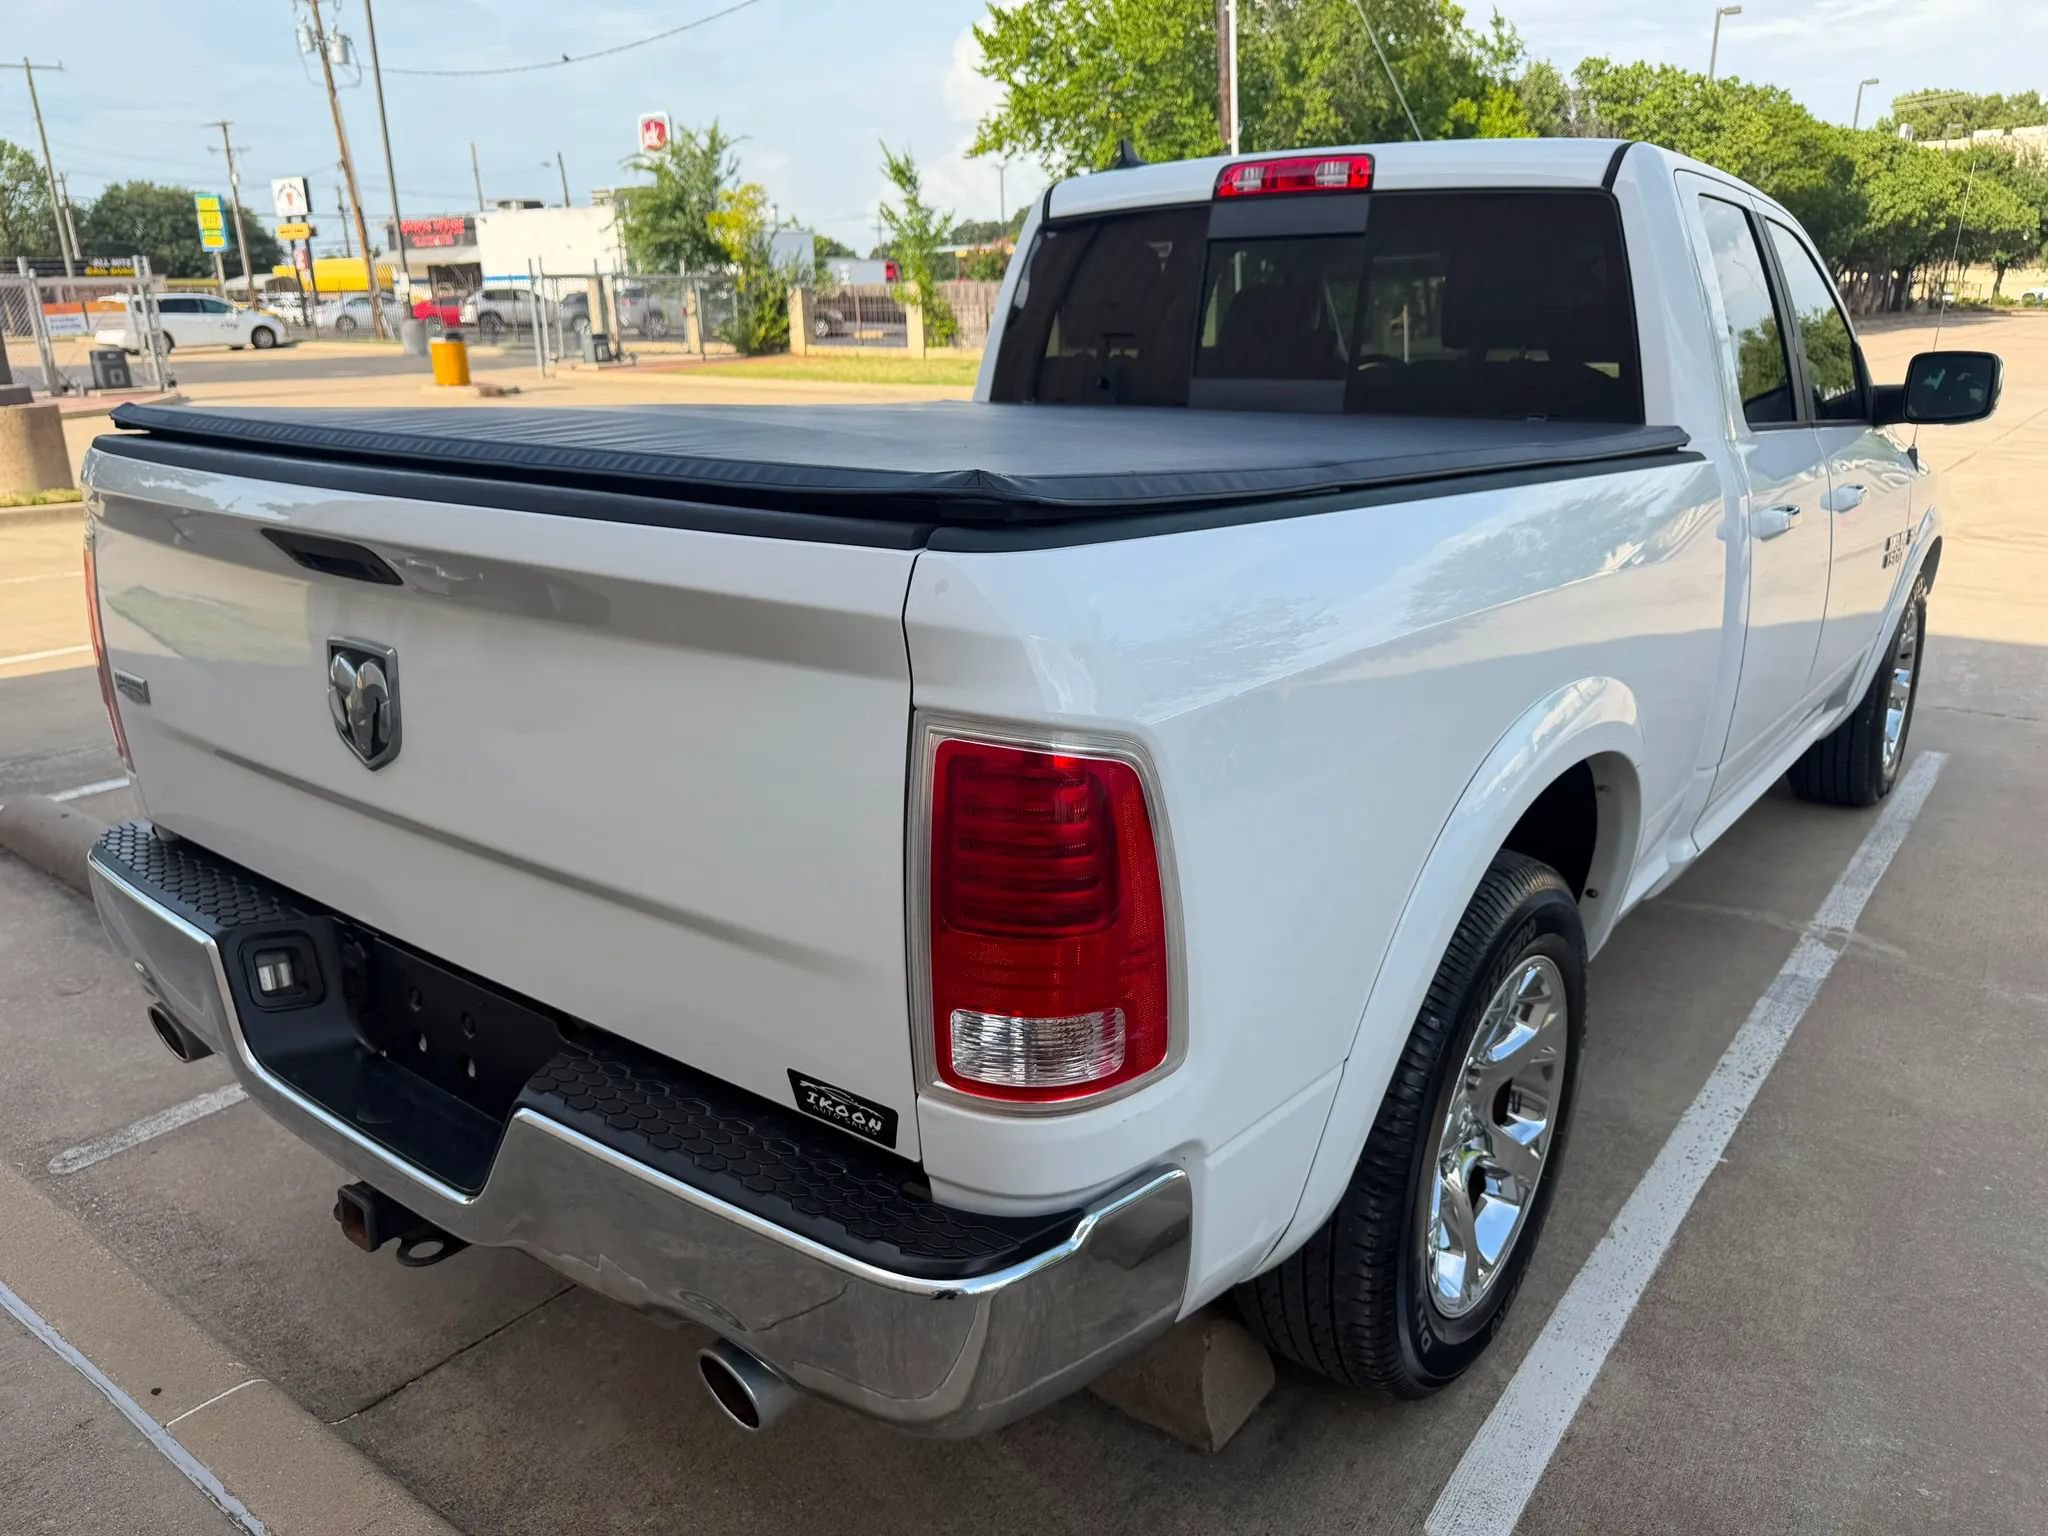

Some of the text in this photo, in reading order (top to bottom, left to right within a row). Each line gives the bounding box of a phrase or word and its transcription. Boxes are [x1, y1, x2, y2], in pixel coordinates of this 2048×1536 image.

[806, 1091, 882, 1132] IKOON
[812, 1104, 878, 1136] AUTO SALES
